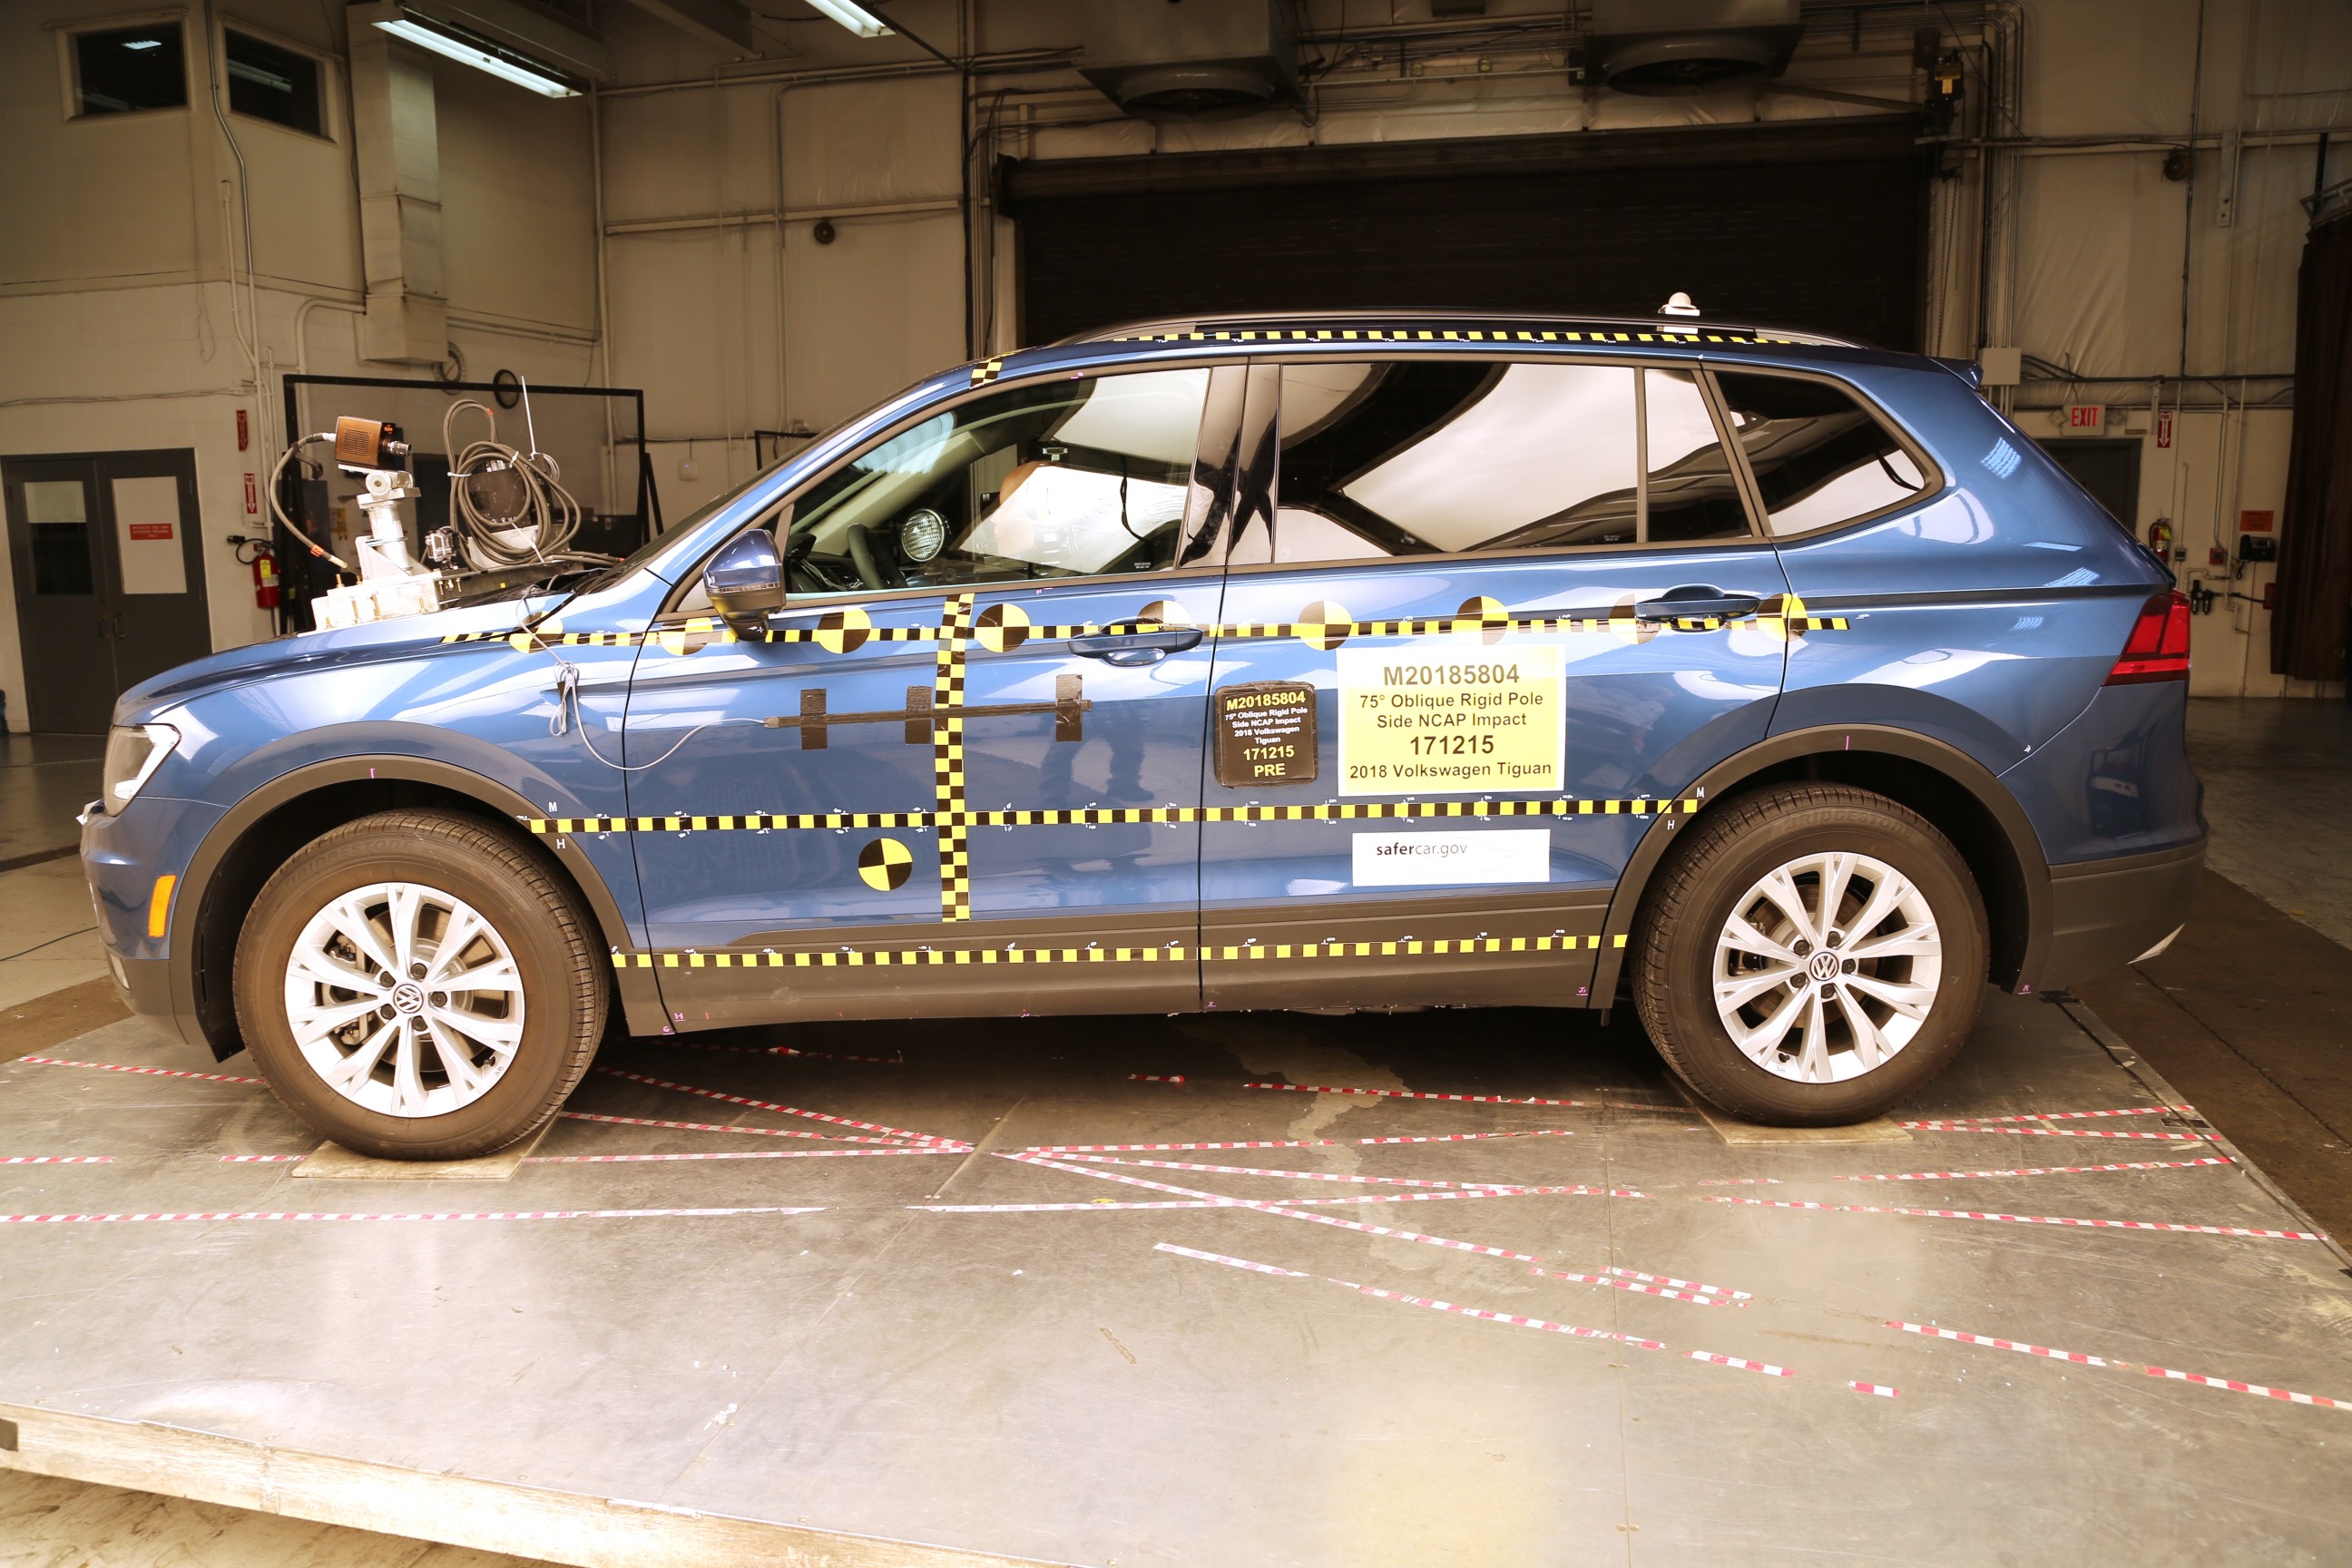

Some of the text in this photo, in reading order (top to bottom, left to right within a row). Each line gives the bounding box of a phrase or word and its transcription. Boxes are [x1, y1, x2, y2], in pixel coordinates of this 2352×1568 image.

[2072, 407, 2100, 426] EXIT
[1383, 663, 1520, 686] M20185804
[1227, 691, 1307, 711] M20185804
[1391, 694, 1455, 710] Oblique
[1461, 692, 1502, 710] Rigid
[1508, 691, 1544, 706] Pole
[1238, 710, 1268, 720] Oblique
[1269, 708, 1289, 718] Rigid
[1291, 706, 1308, 715] Pole
[1377, 712, 1527, 730] Side NCAP Impact
[1232, 716, 1301, 729] Side NCAP Impact
[1234, 726, 1300, 738] 2018 Volkswagen
[1255, 737, 1281, 746] Tiguan
[1410, 734, 1494, 756] 171215
[1243, 745, 1295, 761] 171215
[1254, 762, 1287, 778] PRE
[1349, 762, 1552, 779] 2018 Volkswagen Tiguan
[1696, 786, 1706, 799] M
[548, 801, 558, 812] M
[1667, 819, 1676, 830] H
[556, 838, 566, 849] H
[1377, 842, 1467, 858] safercar.gov
[674, 1012, 683, 1020] H
